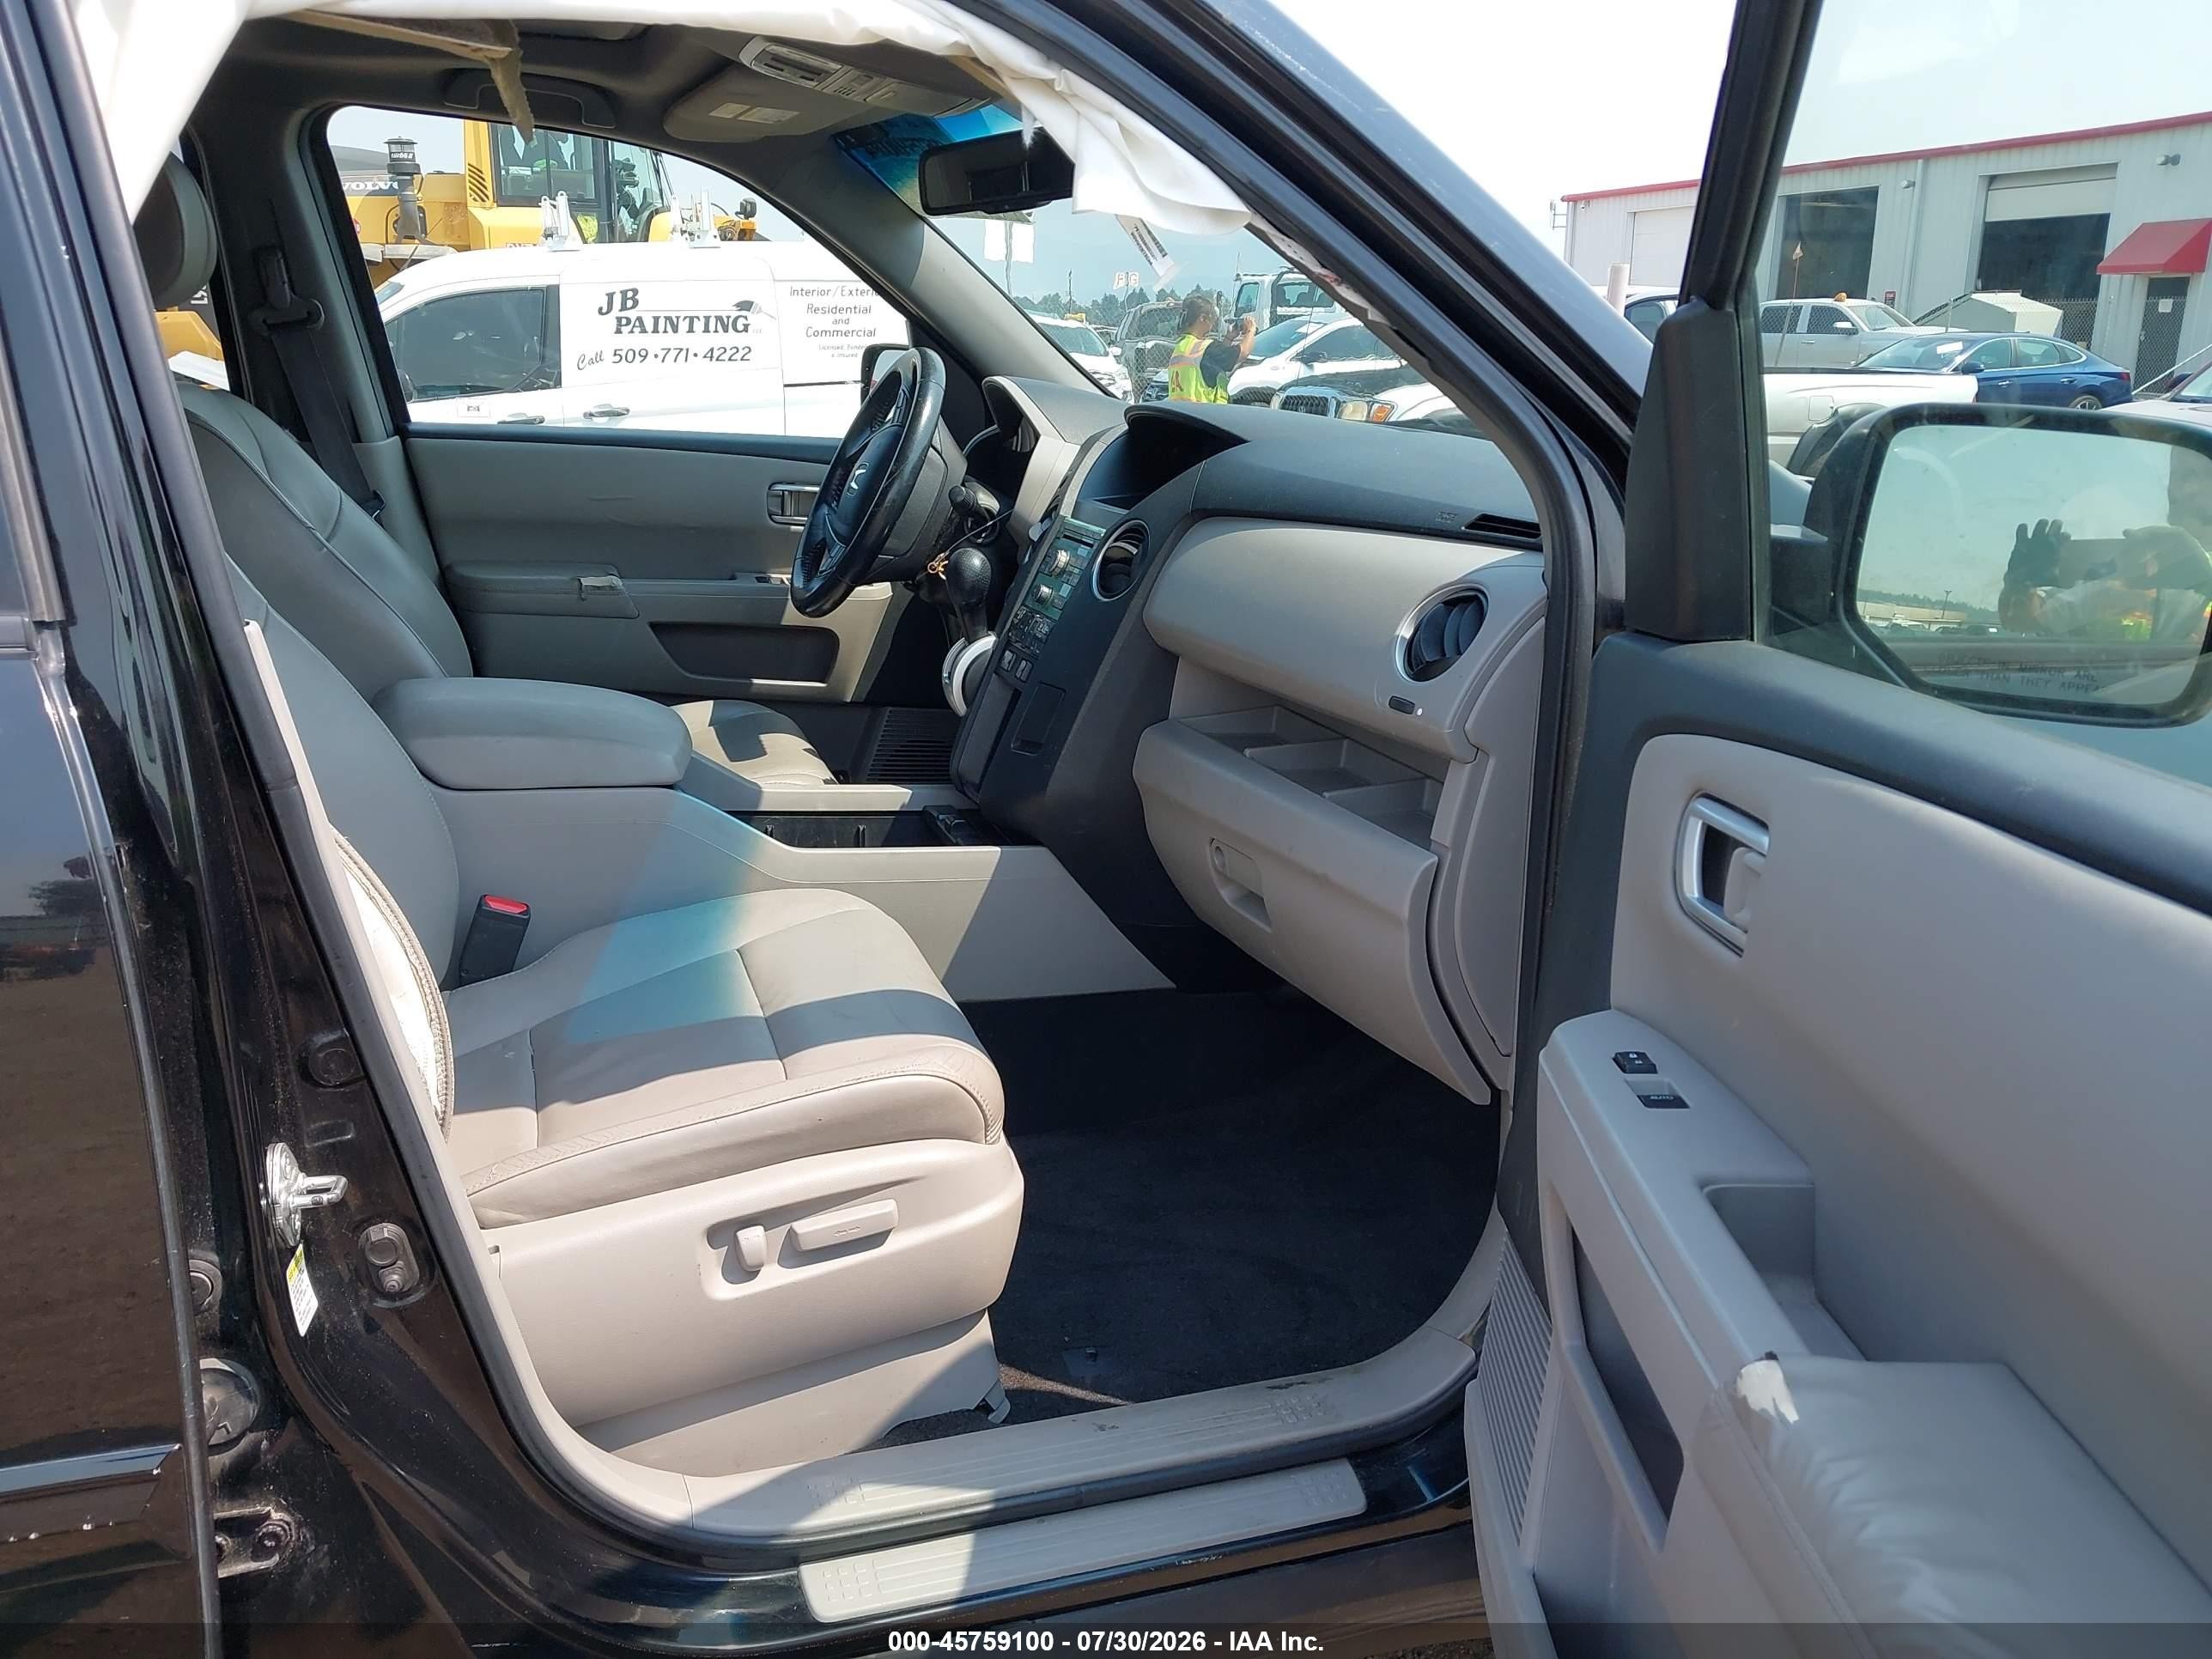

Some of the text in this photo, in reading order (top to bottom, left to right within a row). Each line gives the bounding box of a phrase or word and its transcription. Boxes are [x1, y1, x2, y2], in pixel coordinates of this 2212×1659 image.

[598, 288, 639, 315] JB
[807, 303, 872, 314] Residential
[614, 315, 750, 334] PAINTING
[806, 326, 876, 337] Commercial
[577, 350, 604, 370] Call
[2020, 676, 2051, 688] THEY
